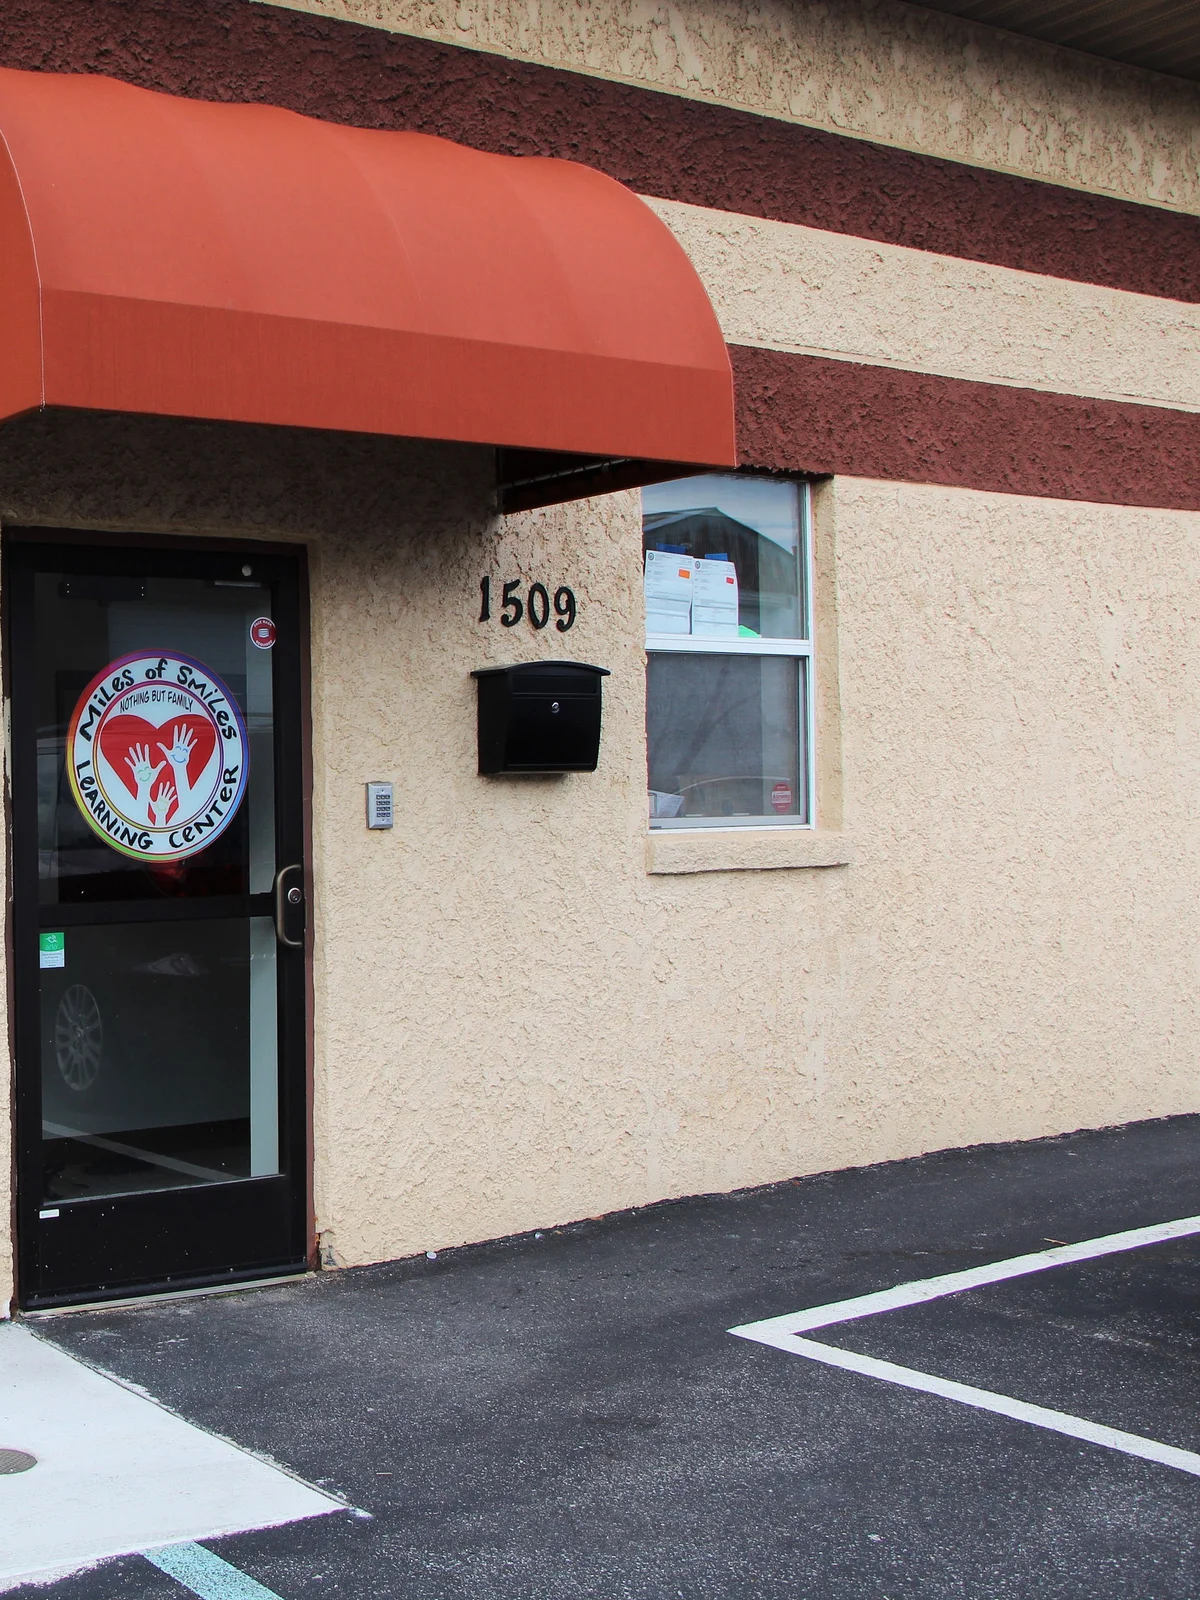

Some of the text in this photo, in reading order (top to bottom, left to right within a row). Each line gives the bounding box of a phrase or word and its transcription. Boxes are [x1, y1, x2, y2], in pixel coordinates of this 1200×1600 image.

[479, 576, 576, 632] 1509
[145, 658, 168, 680] of
[120, 690, 193, 713] NOTHING BUT FAMILY
